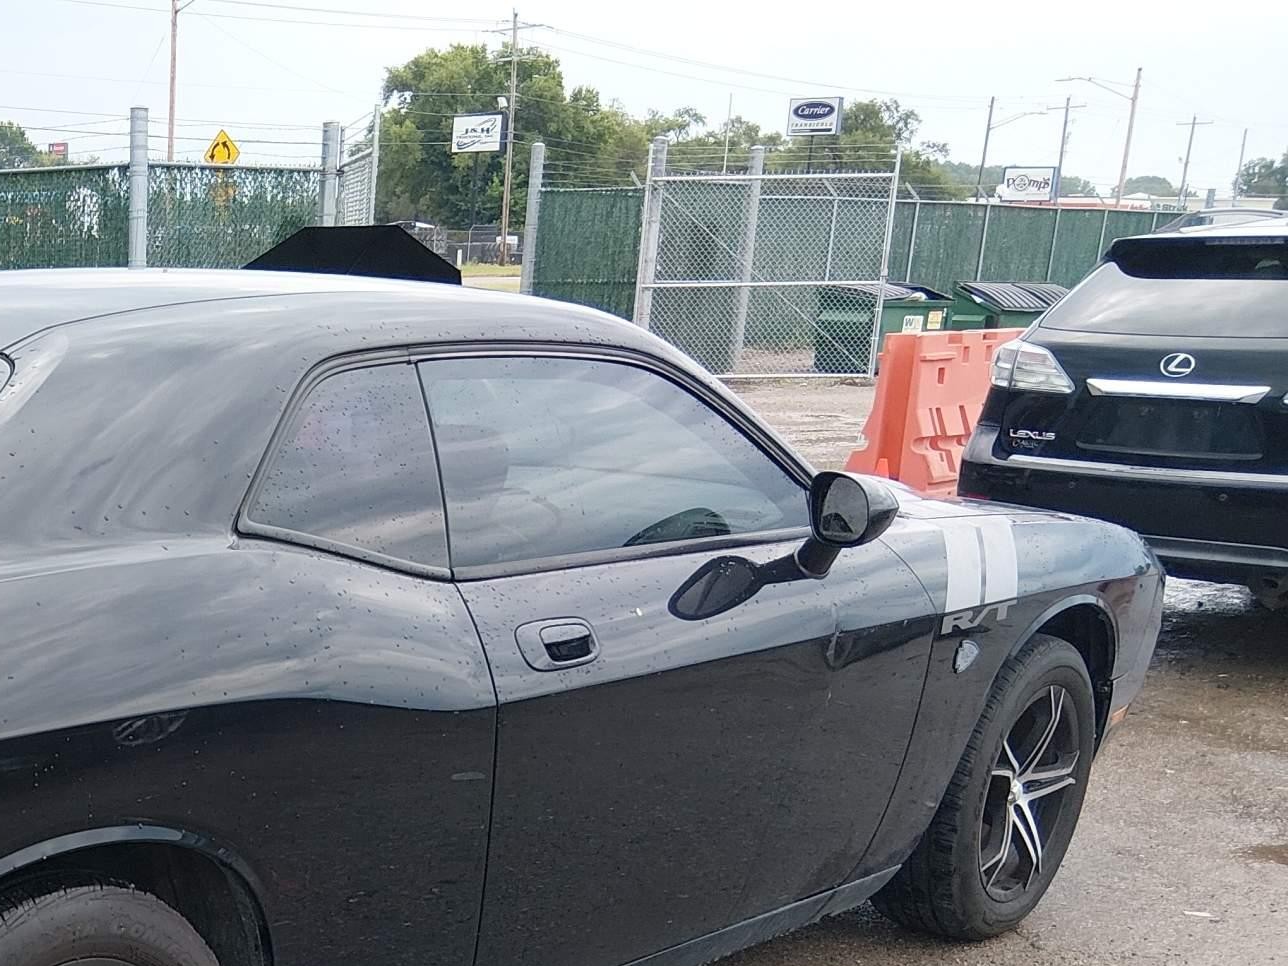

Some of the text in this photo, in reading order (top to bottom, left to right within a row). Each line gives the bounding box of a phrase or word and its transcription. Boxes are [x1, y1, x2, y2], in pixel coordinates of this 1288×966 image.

[798, 105, 831, 115] Carrier
[1009, 429, 1056, 440] LEXUS
[940, 600, 1018, 635] R/T
